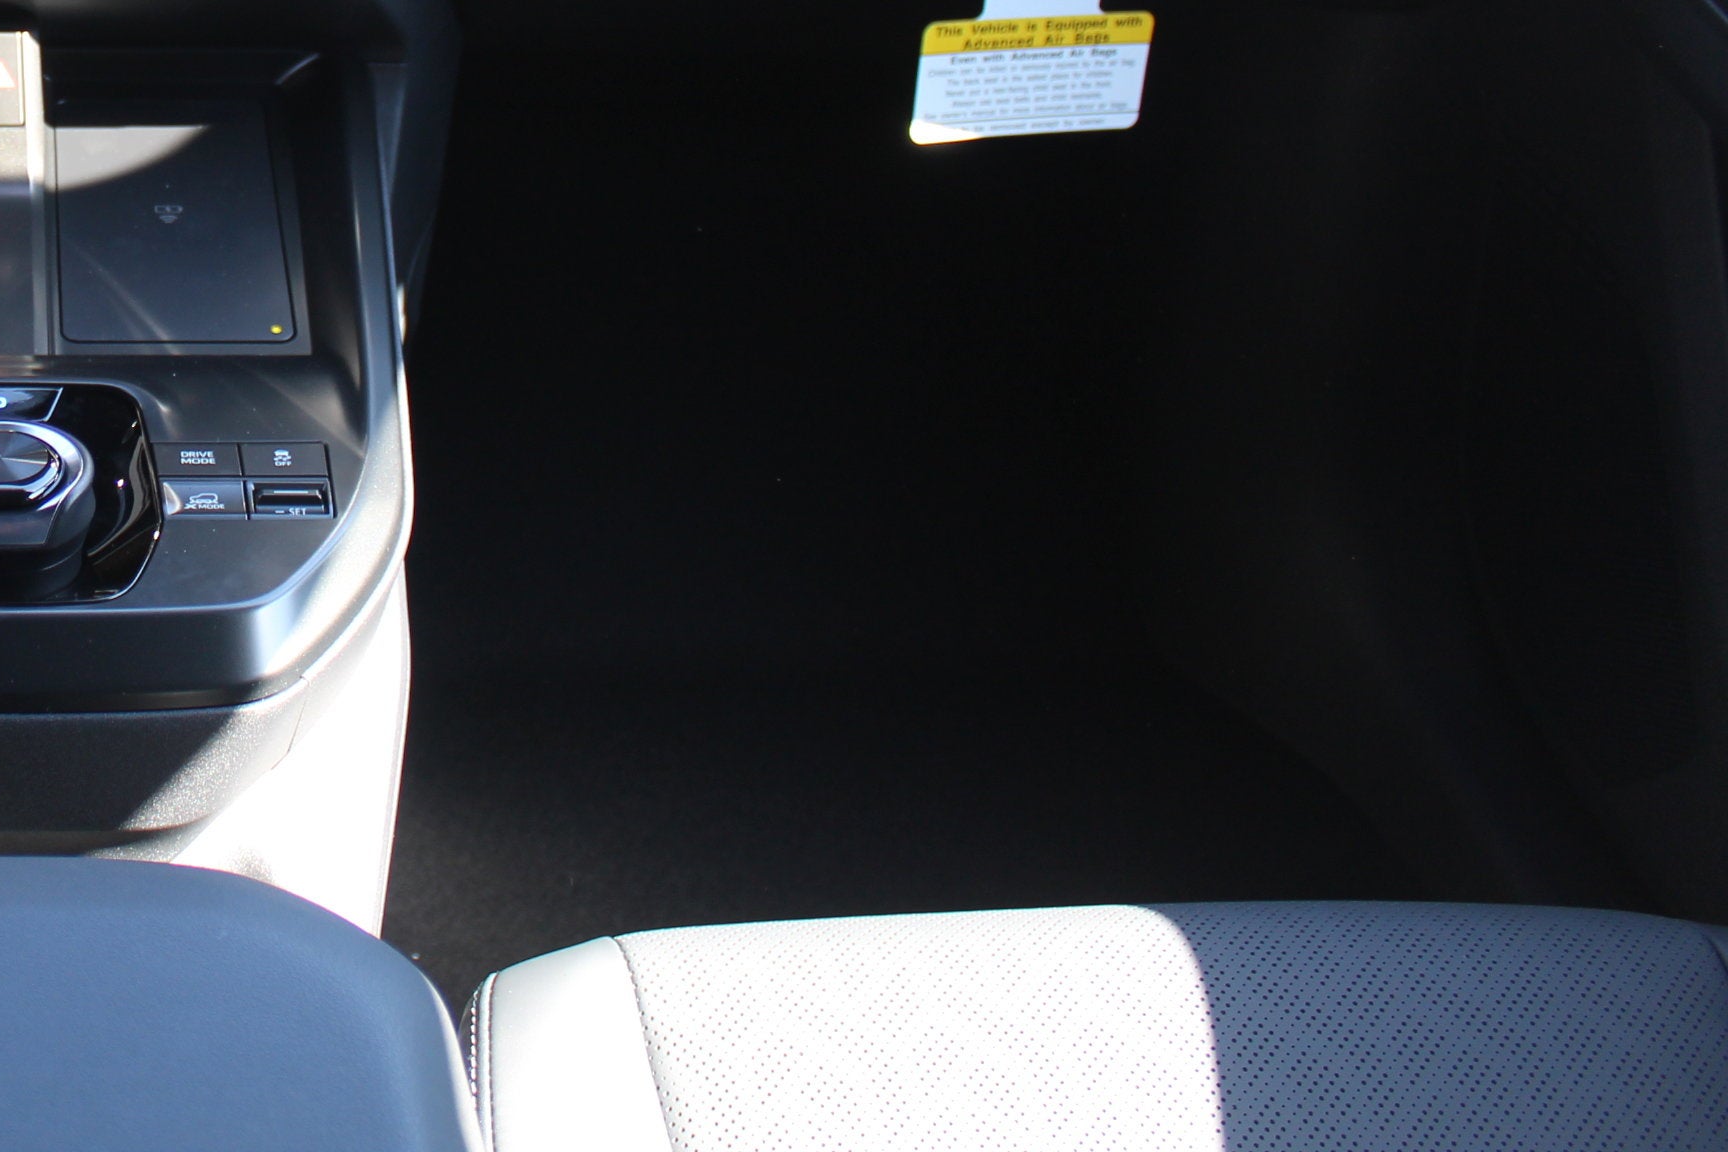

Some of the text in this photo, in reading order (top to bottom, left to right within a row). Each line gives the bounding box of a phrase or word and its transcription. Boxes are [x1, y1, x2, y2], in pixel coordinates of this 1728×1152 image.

[936, 26, 963, 38] This
[971, 22, 1019, 35] Vehicle
[1045, 19, 1108, 32] Equipped
[1115, 16, 1143, 27] with
[963, 33, 1110, 51] Advanced Air Bags
[180, 450, 214, 458] DRIVE
[180, 457, 216, 465] MODE
[288, 507, 307, 516] SET
